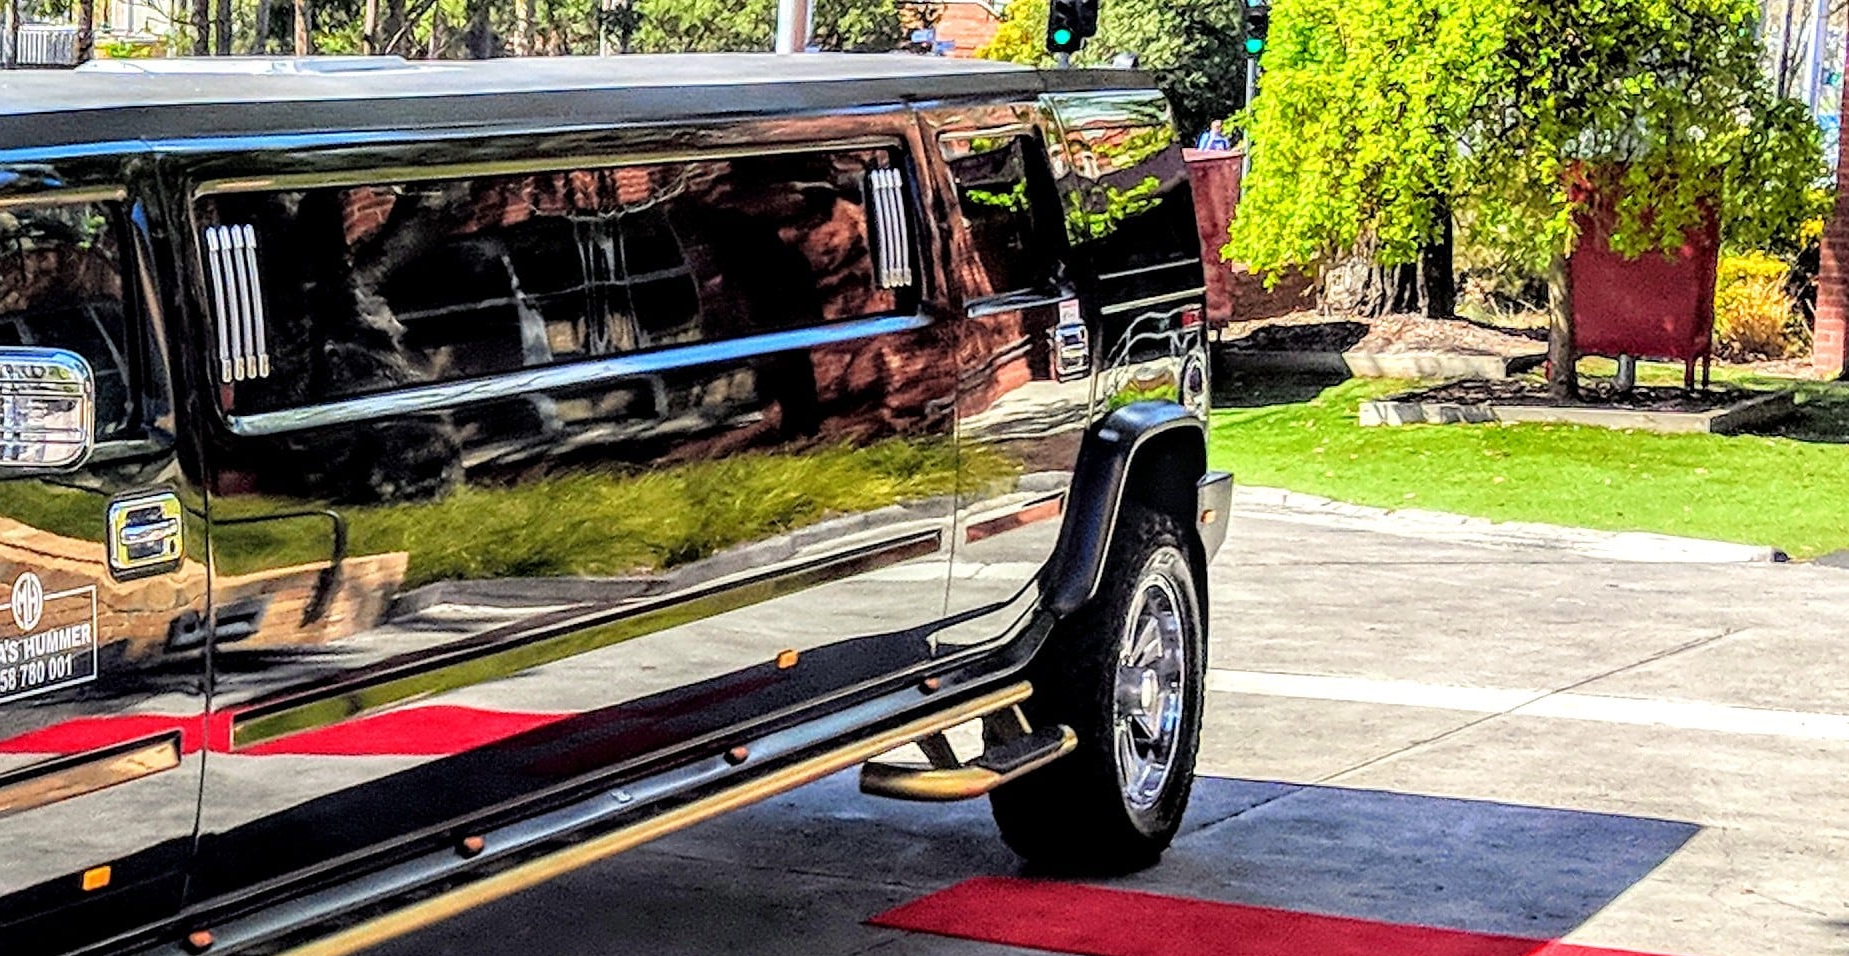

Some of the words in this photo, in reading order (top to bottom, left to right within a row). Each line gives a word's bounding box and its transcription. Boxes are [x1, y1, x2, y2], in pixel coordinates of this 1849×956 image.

[21, 623, 91, 660] HUMMER
[20, 660, 45, 687] 780
[49, 654, 73, 681] 001
